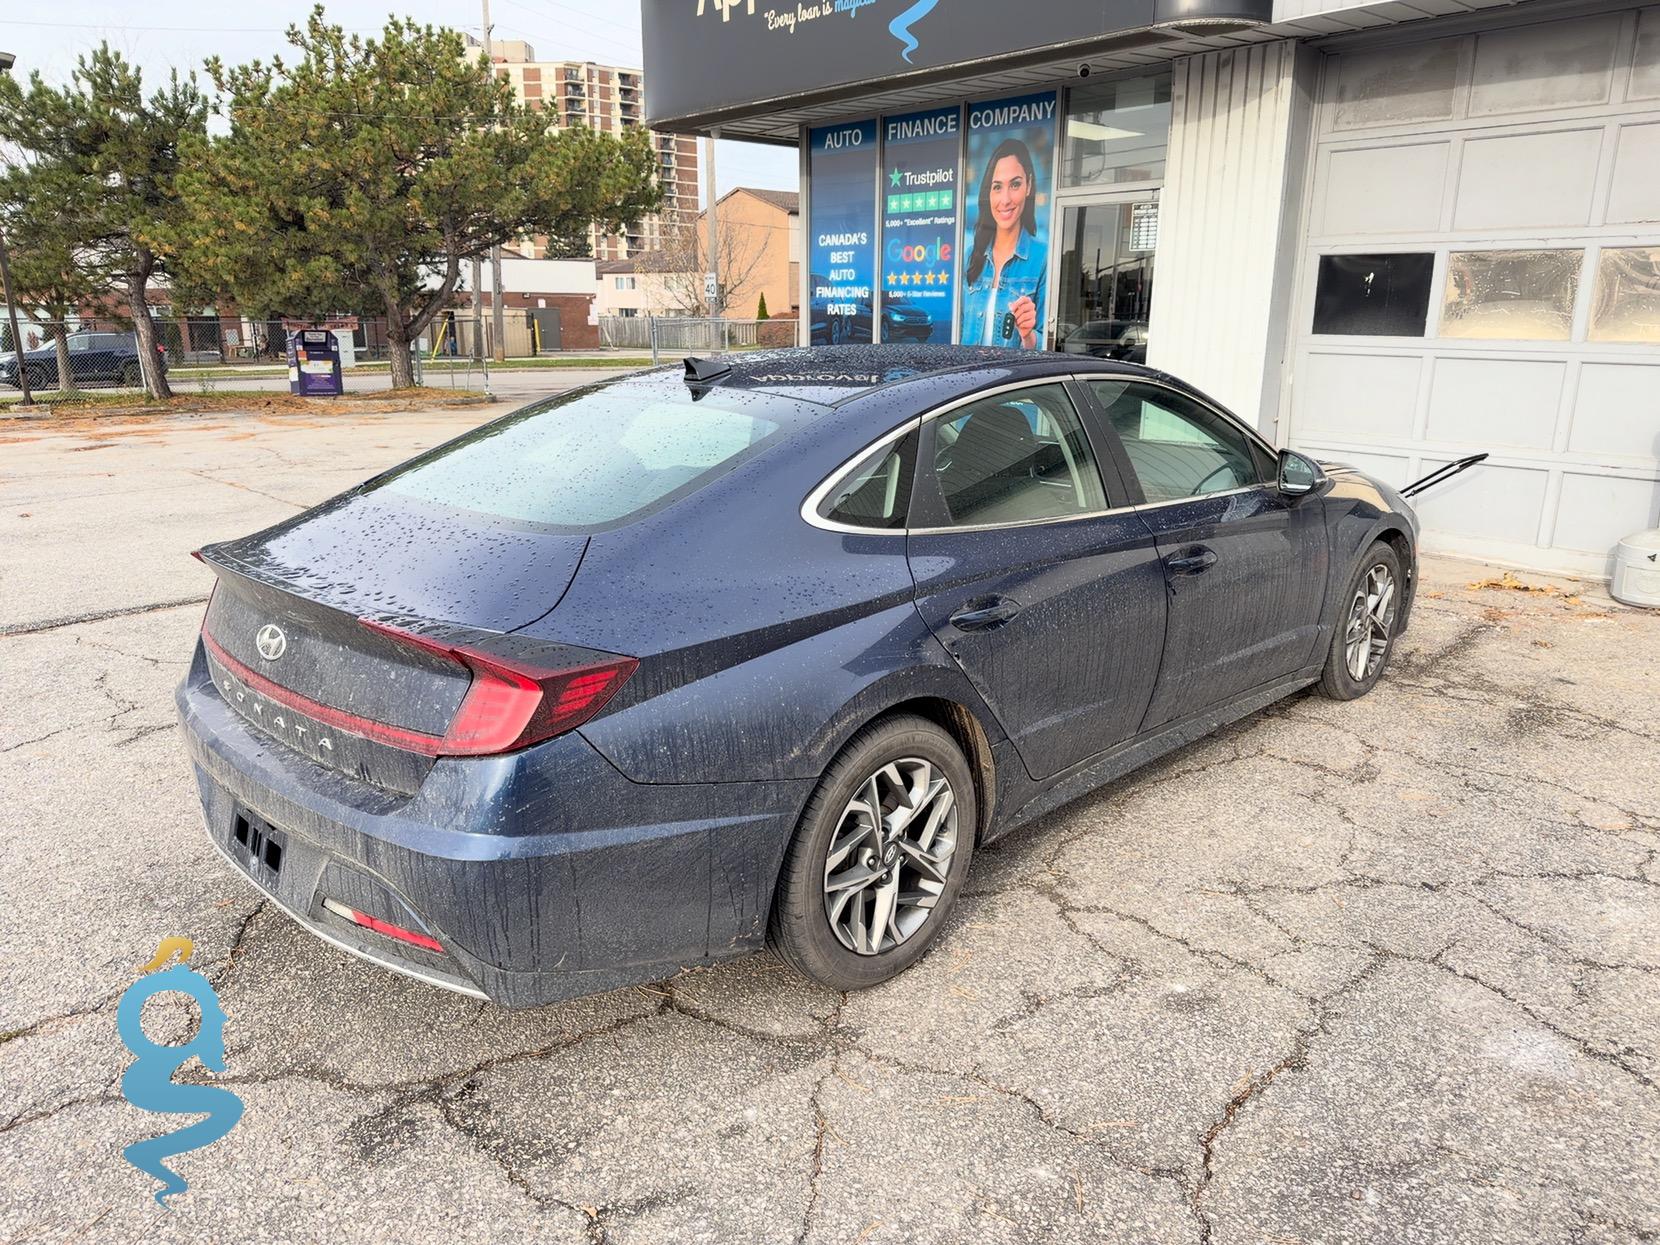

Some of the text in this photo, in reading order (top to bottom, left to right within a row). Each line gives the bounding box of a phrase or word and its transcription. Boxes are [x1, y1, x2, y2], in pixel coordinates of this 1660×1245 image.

[797, 3, 821, 23] loan
[822, 0, 833, 17] is
[824, 100, 1056, 149] AUTO FINANCE COMPANY
[904, 168, 953, 187] Trustpilot
[818, 232, 867, 246] CANADA'S
[830, 251, 854, 263] BEST
[887, 236, 952, 268] Google
[829, 269, 855, 281] AUTO
[705, 283, 716, 295] 40
[816, 286, 869, 298] FINANCING
[827, 303, 857, 316] RATES
[223, 680, 332, 751] SONATA
